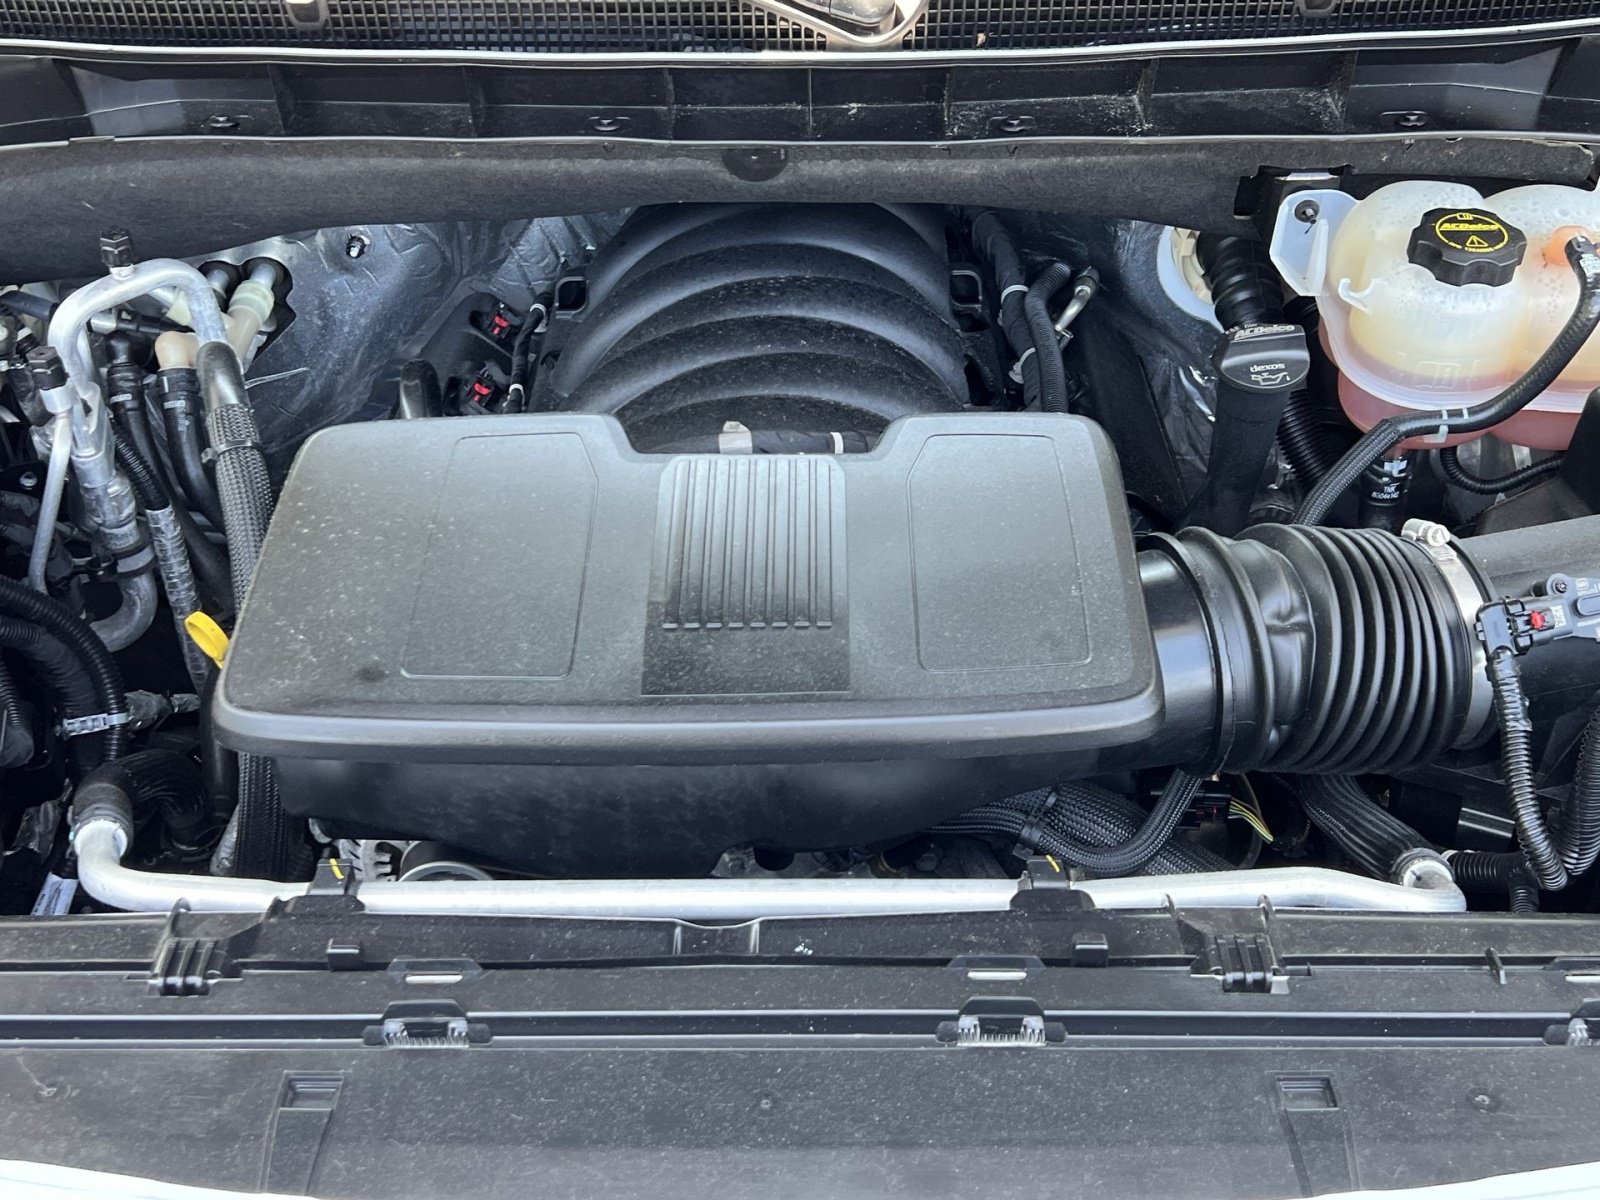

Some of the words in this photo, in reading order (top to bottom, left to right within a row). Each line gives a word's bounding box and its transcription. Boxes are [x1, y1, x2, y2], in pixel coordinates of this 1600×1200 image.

[1439, 222, 1500, 231] ACDelco
[1234, 324, 1296, 340] ACDelco
[1249, 363, 1286, 373] dexos
